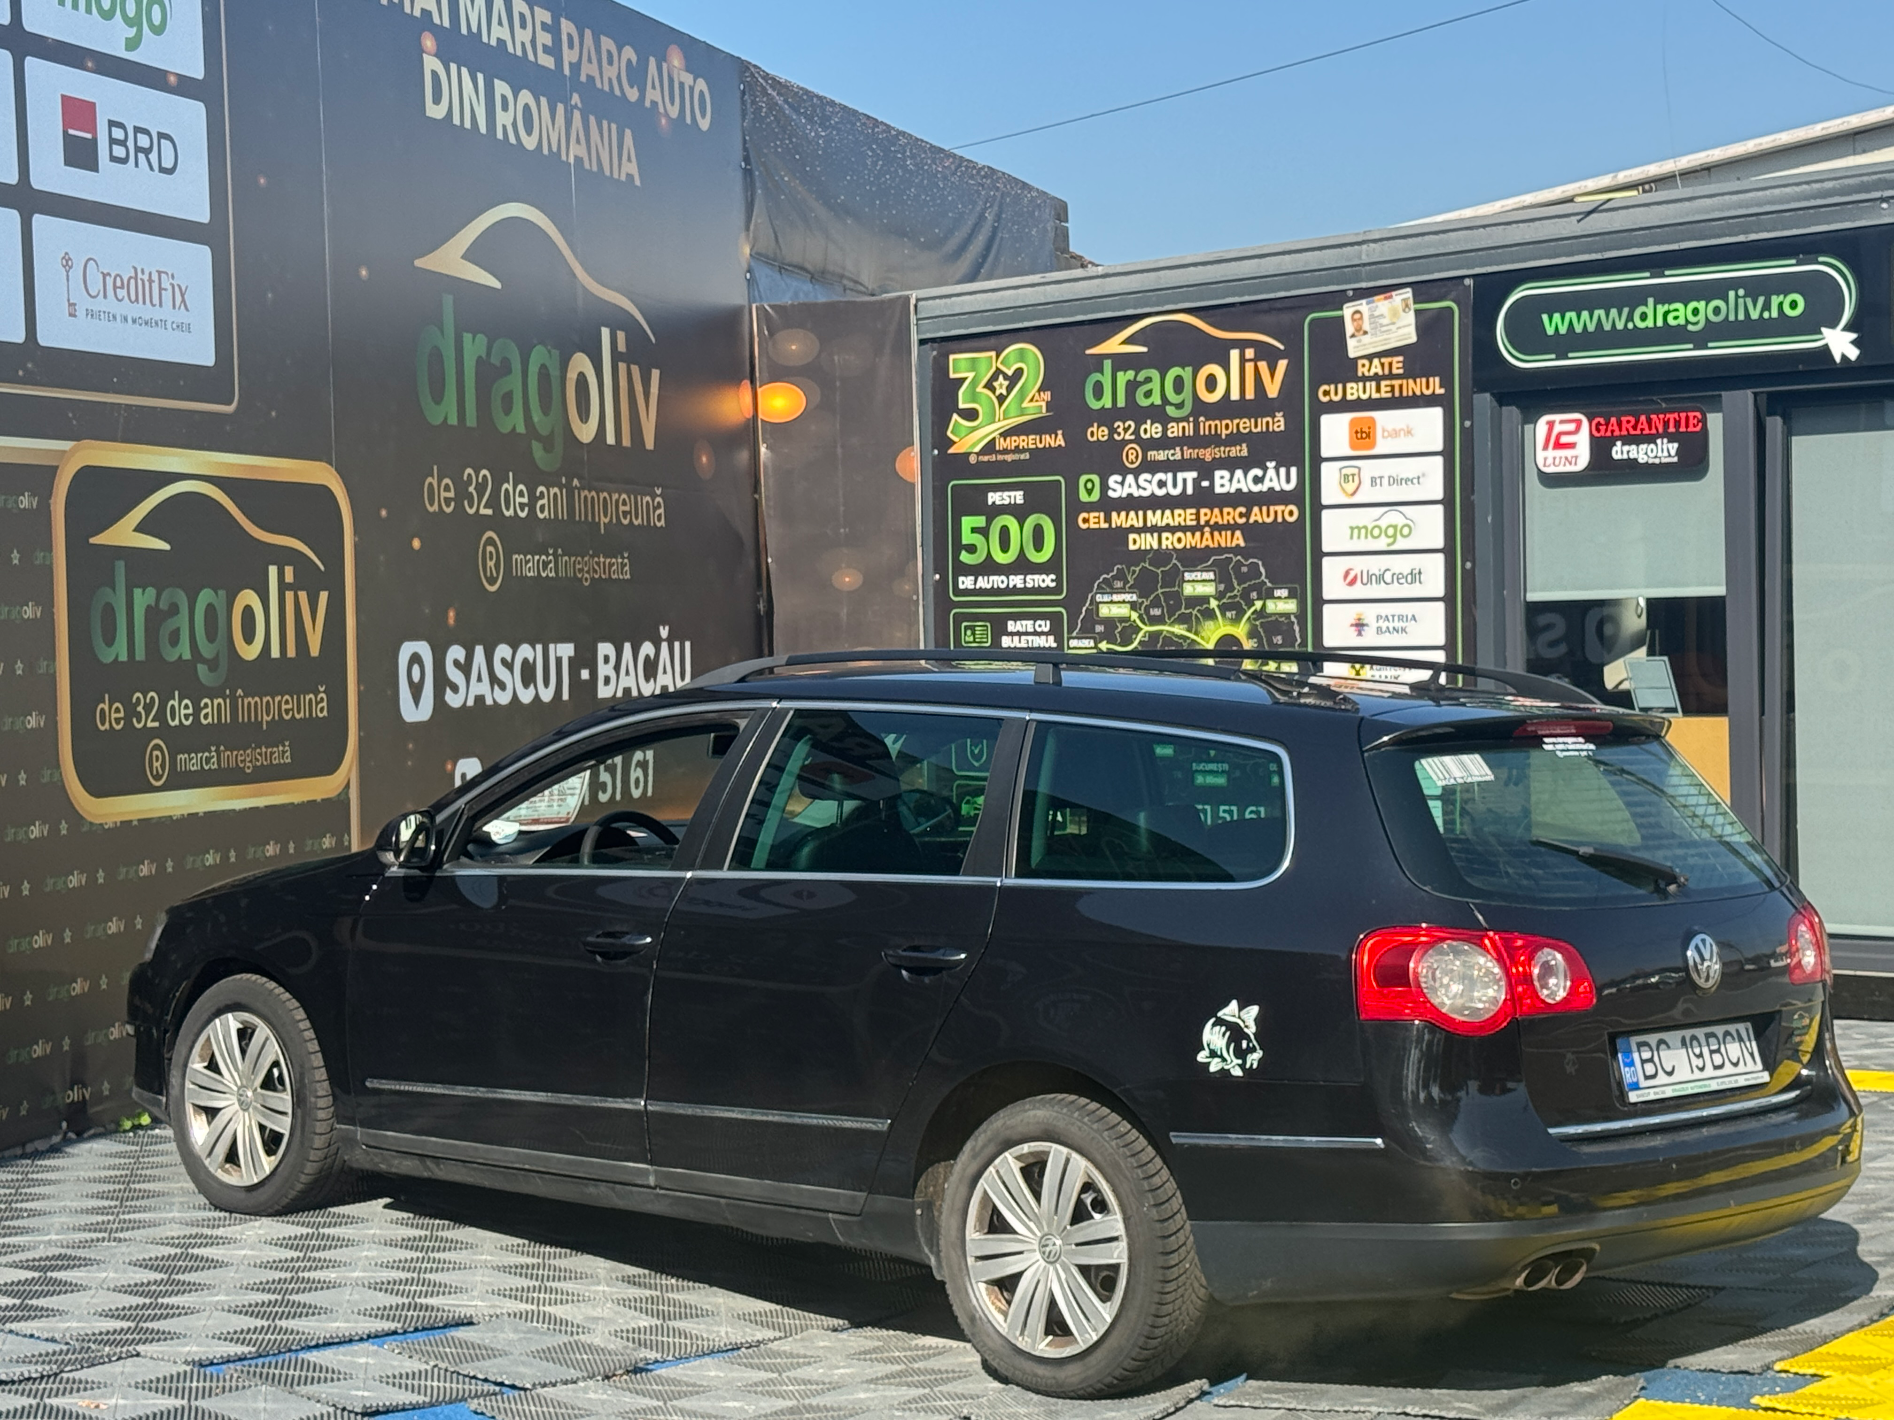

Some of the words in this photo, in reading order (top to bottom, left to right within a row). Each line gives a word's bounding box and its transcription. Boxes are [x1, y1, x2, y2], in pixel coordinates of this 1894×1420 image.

[58, 0, 168, 52] ogo
[459, 0, 555, 70] MARE
[560, 17, 639, 102] PARC
[645, 56, 712, 131] AUTO
[422, 52, 487, 135] DIN
[493, 78, 641, 187] ROMÂNIA
[107, 118, 179, 176] BRD
[82, 257, 190, 312] CreditFix
[85, 308, 117, 323] PRIETEN
[120, 314, 129, 324] IN
[131, 318, 168, 331] MOMENTE
[171, 321, 192, 334] CHEIE
[1541, 288, 1806, 336] www.dragoliv.ro
[1356, 356, 1404, 377] RATE
[416, 293, 661, 472] dragoliv
[1084, 348, 1289, 418] dragoliv
[1317, 383, 1343, 403] CU
[1345, 376, 1446, 401] BULETINUL
[1032, 391, 1051, 403] ANI
[1086, 423, 1109, 443] de
[1113, 421, 1136, 440] 32
[1140, 419, 1163, 439] de
[1166, 417, 1194, 437] ani
[1198, 412, 1285, 440] împreună
[1354, 427, 1372, 441] tbi
[1381, 425, 1414, 440] bank
[1542, 418, 1583, 452] 12
[1590, 411, 1703, 438] GARANTIE
[995, 430, 1065, 451] ÎMPREUNĂ
[1147, 447, 1182, 463] marcă
[1183, 444, 1248, 462] înregistrată
[1611, 438, 1679, 463] dragoliv
[1542, 455, 1579, 468] LUNI
[1107, 471, 1197, 499] SASCUT
[1213, 461, 1298, 493] BACĂU
[1343, 473, 1357, 484] BT
[1370, 476, 1384, 487] BT
[424, 465, 455, 513] de
[463, 467, 493, 516] 32
[500, 471, 529, 518] de
[536, 477, 567, 520] ani
[572, 477, 665, 534] împreună
[987, 490, 1024, 506] PESTE
[1077, 512, 1109, 529] CEL
[1111, 510, 1144, 529] MAI
[1146, 508, 1197, 528] MARE
[1198, 506, 1249, 526] PARC
[1249, 504, 1299, 524] AUTO
[958, 513, 1056, 566] 500
[1128, 532, 1162, 550] DIN
[1164, 527, 1245, 549] ROMÂNIA
[1349, 523, 1413, 547] mogo
[512, 548, 555, 578] marcă
[558, 548, 631, 586] înregistrată
[1360, 568, 1423, 586] UniCredit
[958, 576, 976, 589] DE
[976, 576, 1007, 589] AUTO
[1007, 575, 1024, 588] PE
[1025, 574, 1056, 588] STOC
[89, 559, 329, 687] dragoliv
[1007, 620, 1034, 632] RATE
[1034, 620, 1050, 632] CU
[1376, 614, 1418, 624] PATRIA
[1376, 625, 1409, 635] BANK
[1001, 635, 1057, 648] BULETINUL
[444, 642, 575, 709] SASCUT
[597, 625, 692, 699] BACĂU
[96, 693, 125, 731] de
[132, 691, 160, 729] 32
[166, 690, 194, 728] de
[200, 689, 230, 725] ani
[236, 684, 328, 730] împreună
[176, 745, 218, 773] marcă
[219, 741, 291, 774] înregistrată
[630, 749, 654, 799] 61
[1635, 1038, 1676, 1081] BC
[1624, 1066, 1638, 1084] RO
